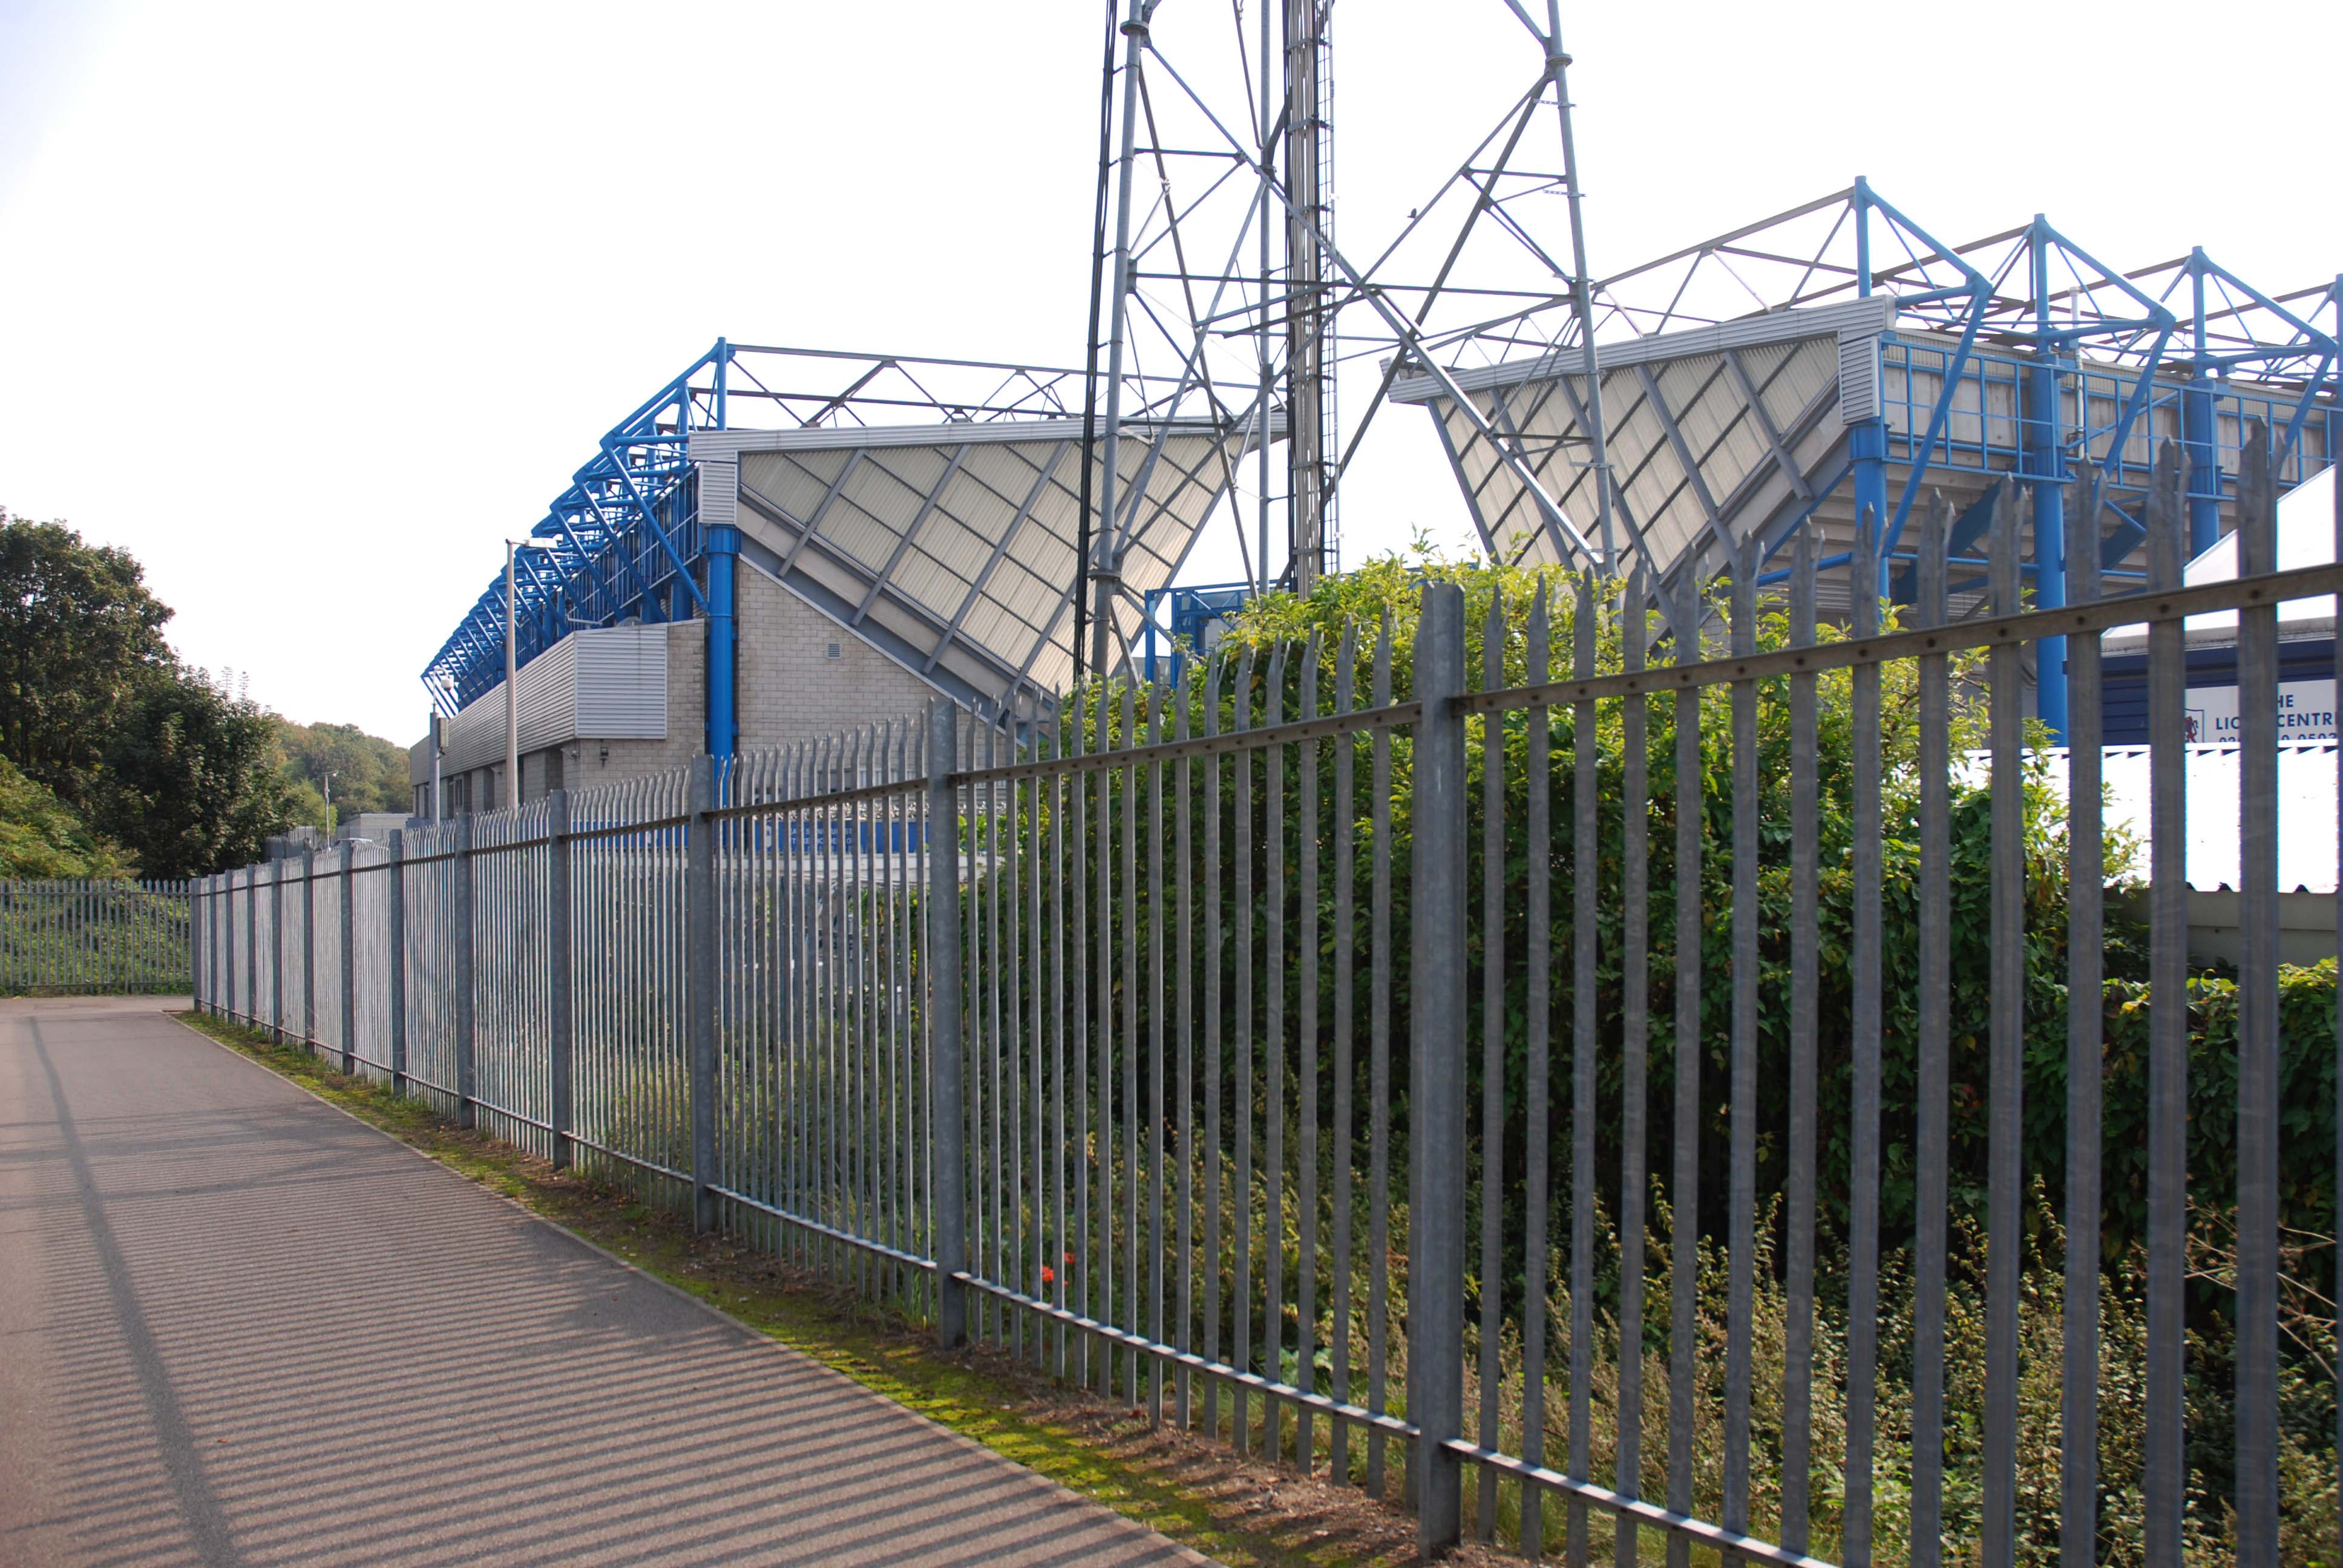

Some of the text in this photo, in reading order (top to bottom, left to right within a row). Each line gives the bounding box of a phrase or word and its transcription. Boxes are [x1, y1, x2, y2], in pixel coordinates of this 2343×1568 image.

[2277, 694, 2293, 708] HE
[2216, 712, 2338, 730] LIO CENTR
